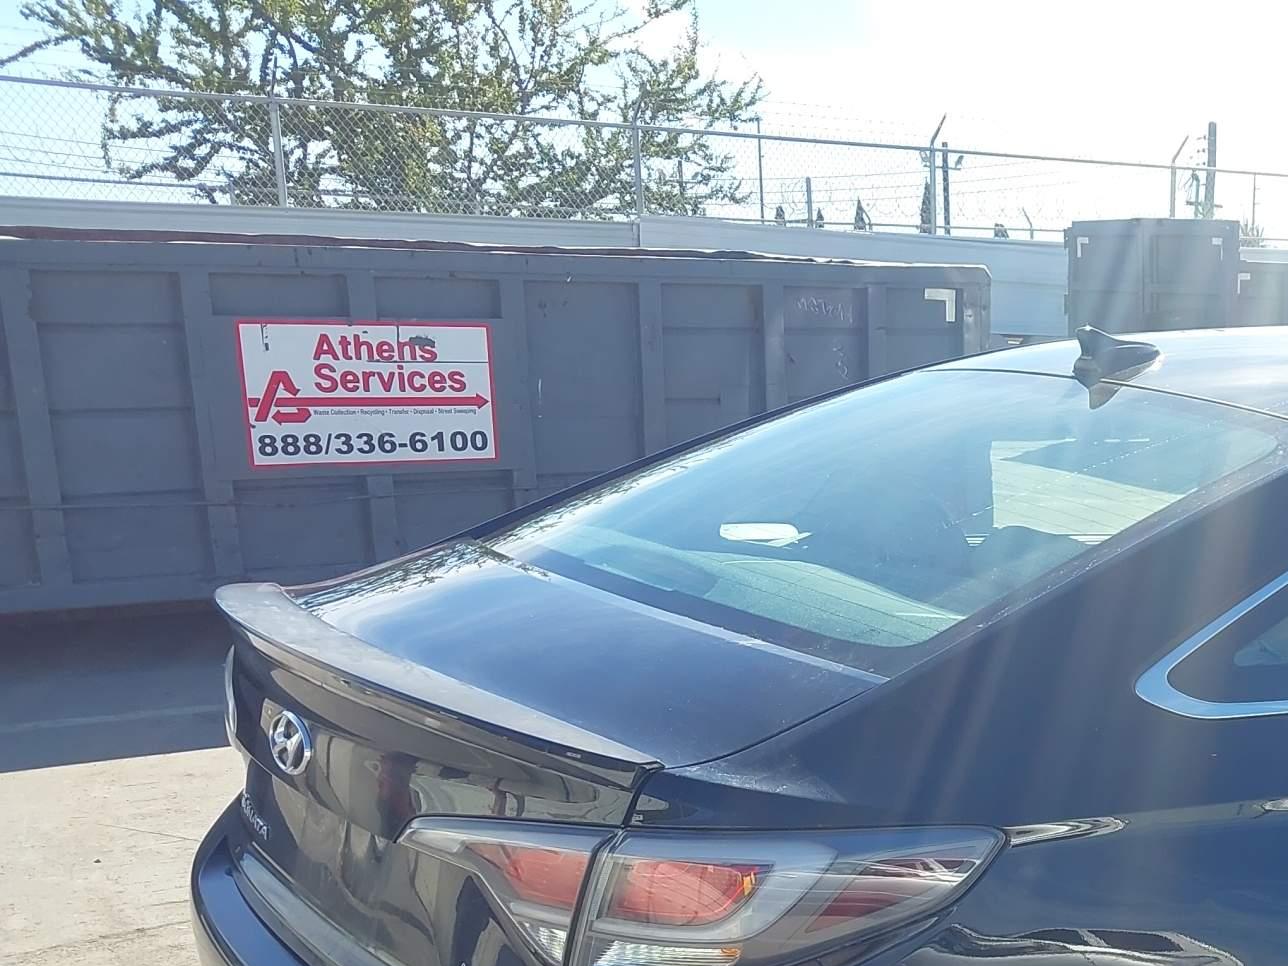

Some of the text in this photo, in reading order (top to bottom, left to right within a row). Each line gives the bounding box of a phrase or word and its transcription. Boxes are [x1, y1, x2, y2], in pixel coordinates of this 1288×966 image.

[312, 333, 439, 362] Athens
[313, 363, 467, 393] Services
[257, 431, 489, 456] 888/336-6100
